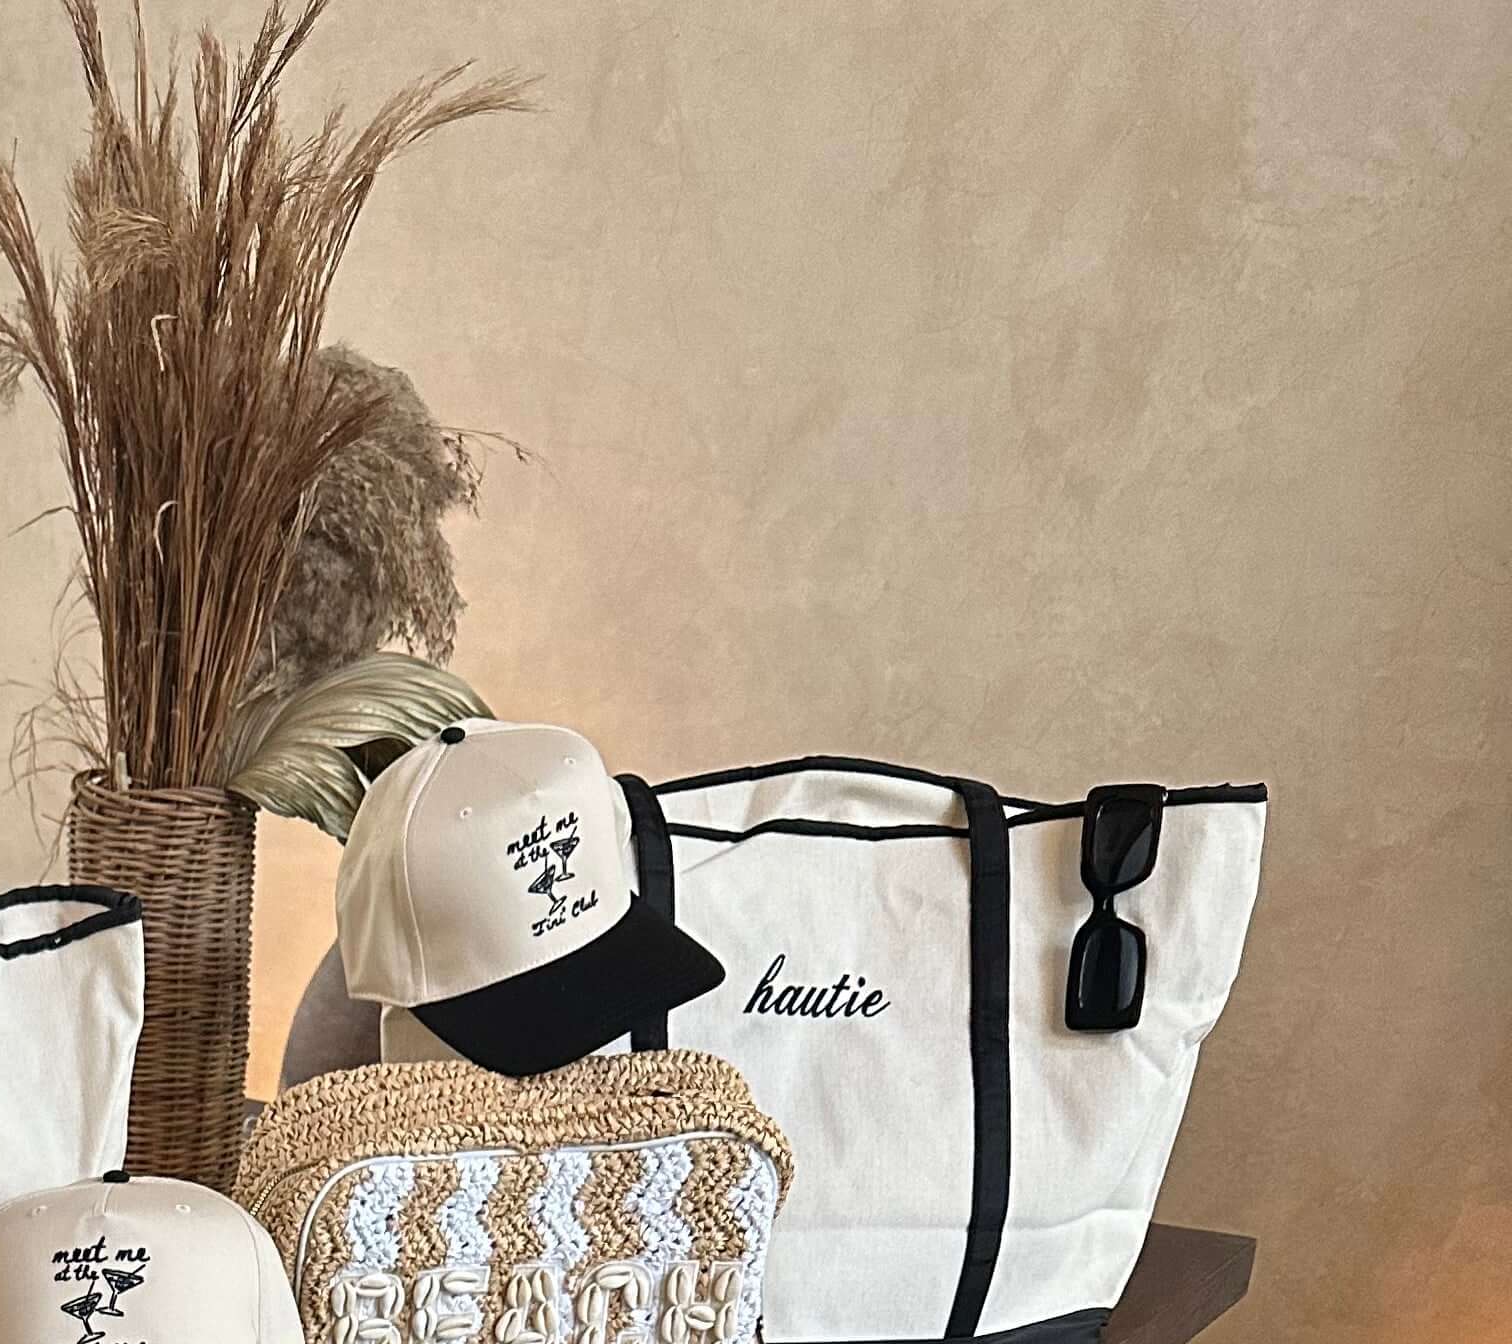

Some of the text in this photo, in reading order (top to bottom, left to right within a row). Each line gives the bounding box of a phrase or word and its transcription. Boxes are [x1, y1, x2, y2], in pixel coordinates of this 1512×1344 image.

[507, 811, 579, 856] meet me
[571, 889, 599, 918] Club
[743, 953, 891, 1018] hautie
[51, 1235, 151, 1264] meet me
[54, 1264, 100, 1282] at the
